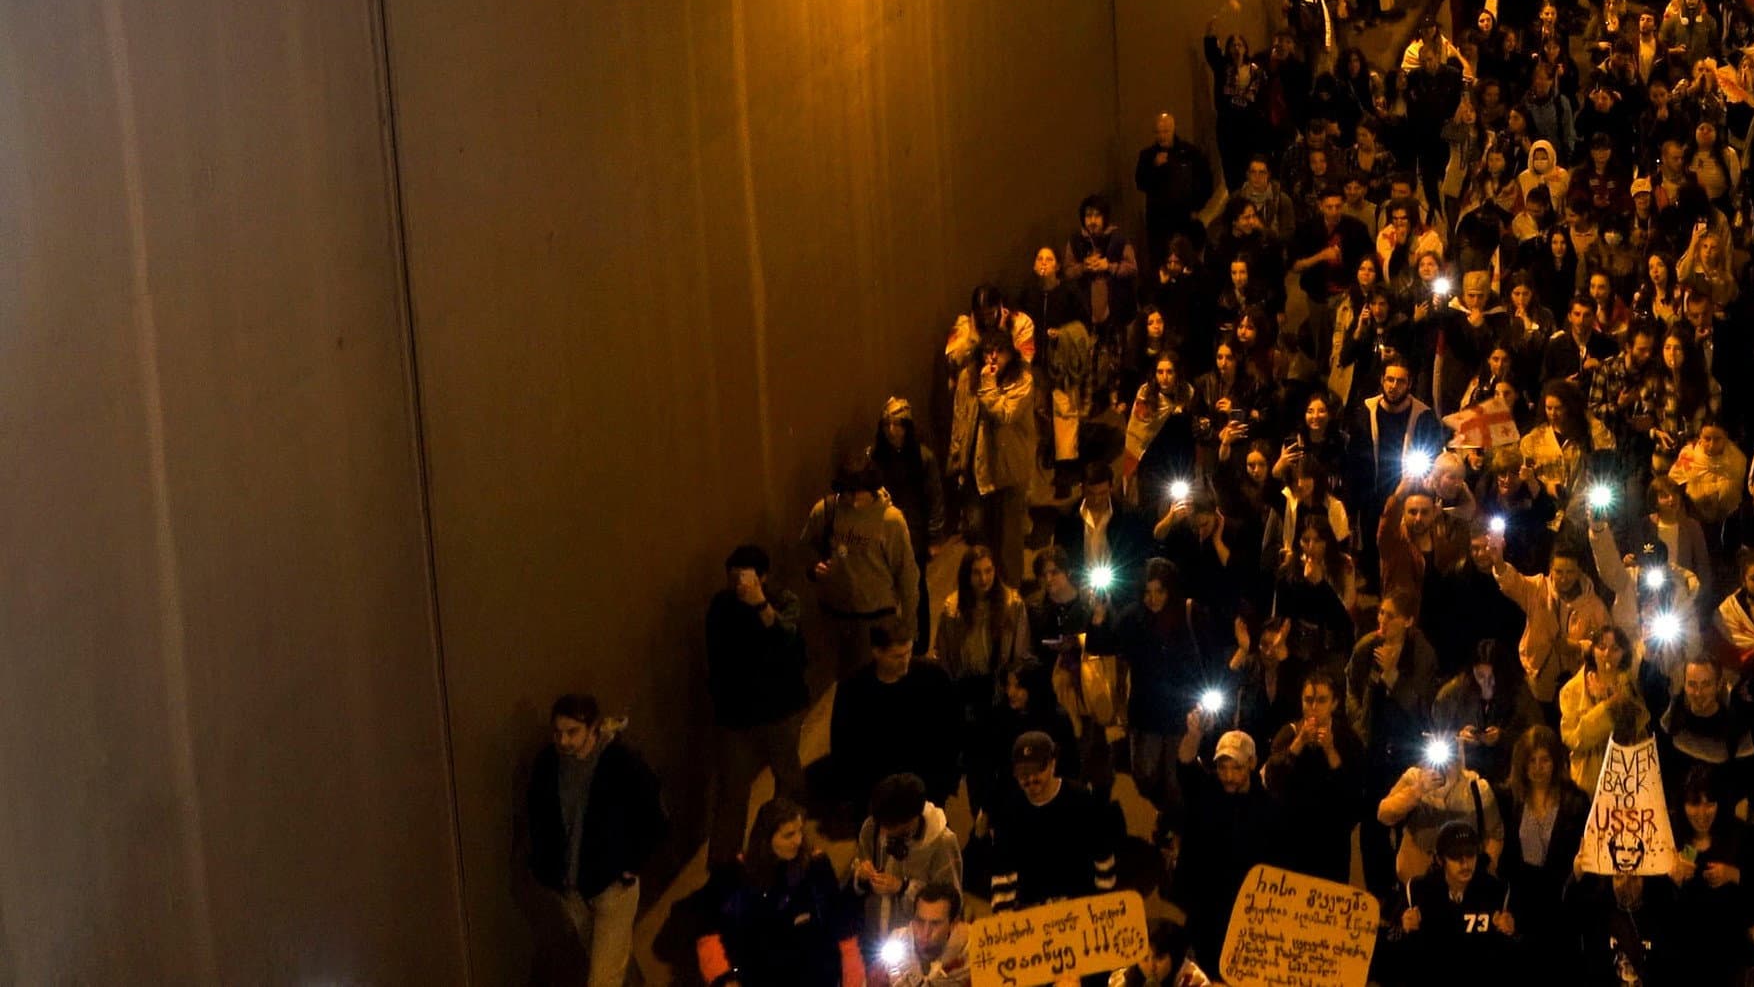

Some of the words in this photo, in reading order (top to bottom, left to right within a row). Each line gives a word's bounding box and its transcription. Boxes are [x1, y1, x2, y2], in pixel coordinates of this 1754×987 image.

[1603, 770, 1649, 795] BACK
[1613, 792, 1635, 810] TO
[1596, 804, 1658, 835] USSR
[1464, 914, 1489, 933] 73
